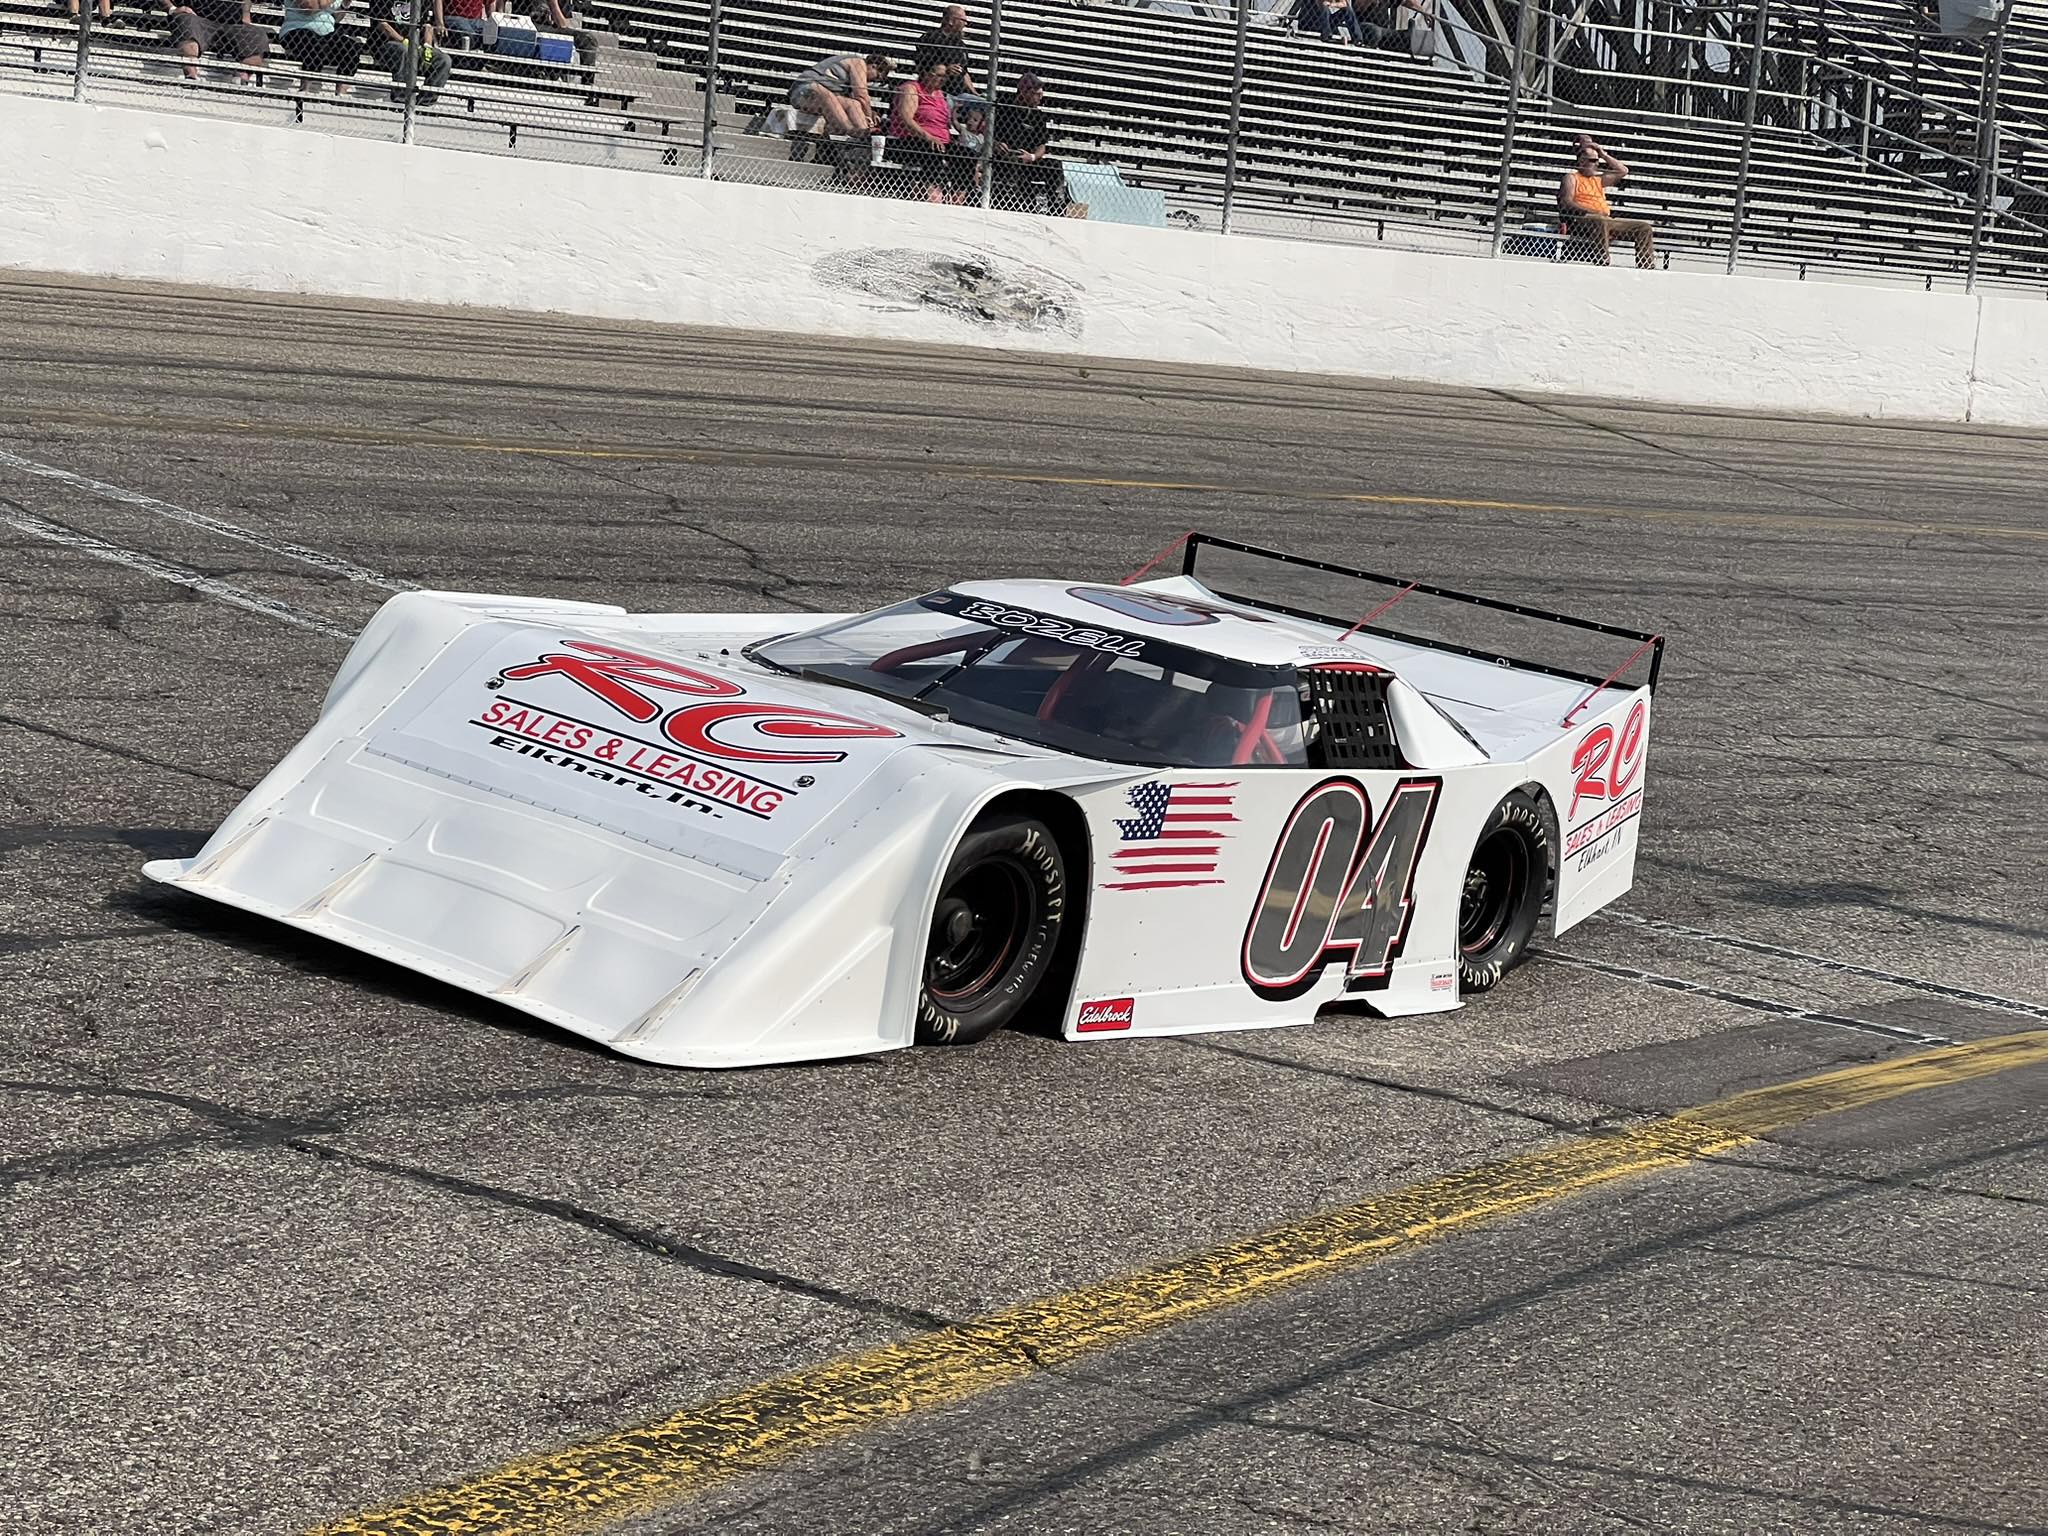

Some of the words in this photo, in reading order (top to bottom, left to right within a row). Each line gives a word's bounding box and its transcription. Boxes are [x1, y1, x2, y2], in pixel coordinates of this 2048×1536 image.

[959, 601, 1147, 658] BOZELL
[499, 640, 905, 762] RC
[481, 703, 593, 750] SALES
[594, 738, 624, 761] &
[625, 746, 784, 815] LEASING
[1568, 698, 1645, 822] RC
[1565, 823, 1594, 856] SALES
[1606, 791, 1642, 830] LEASING
[1240, 775, 1443, 1002] 04
[1079, 1004, 1132, 1025] Edelbrock
